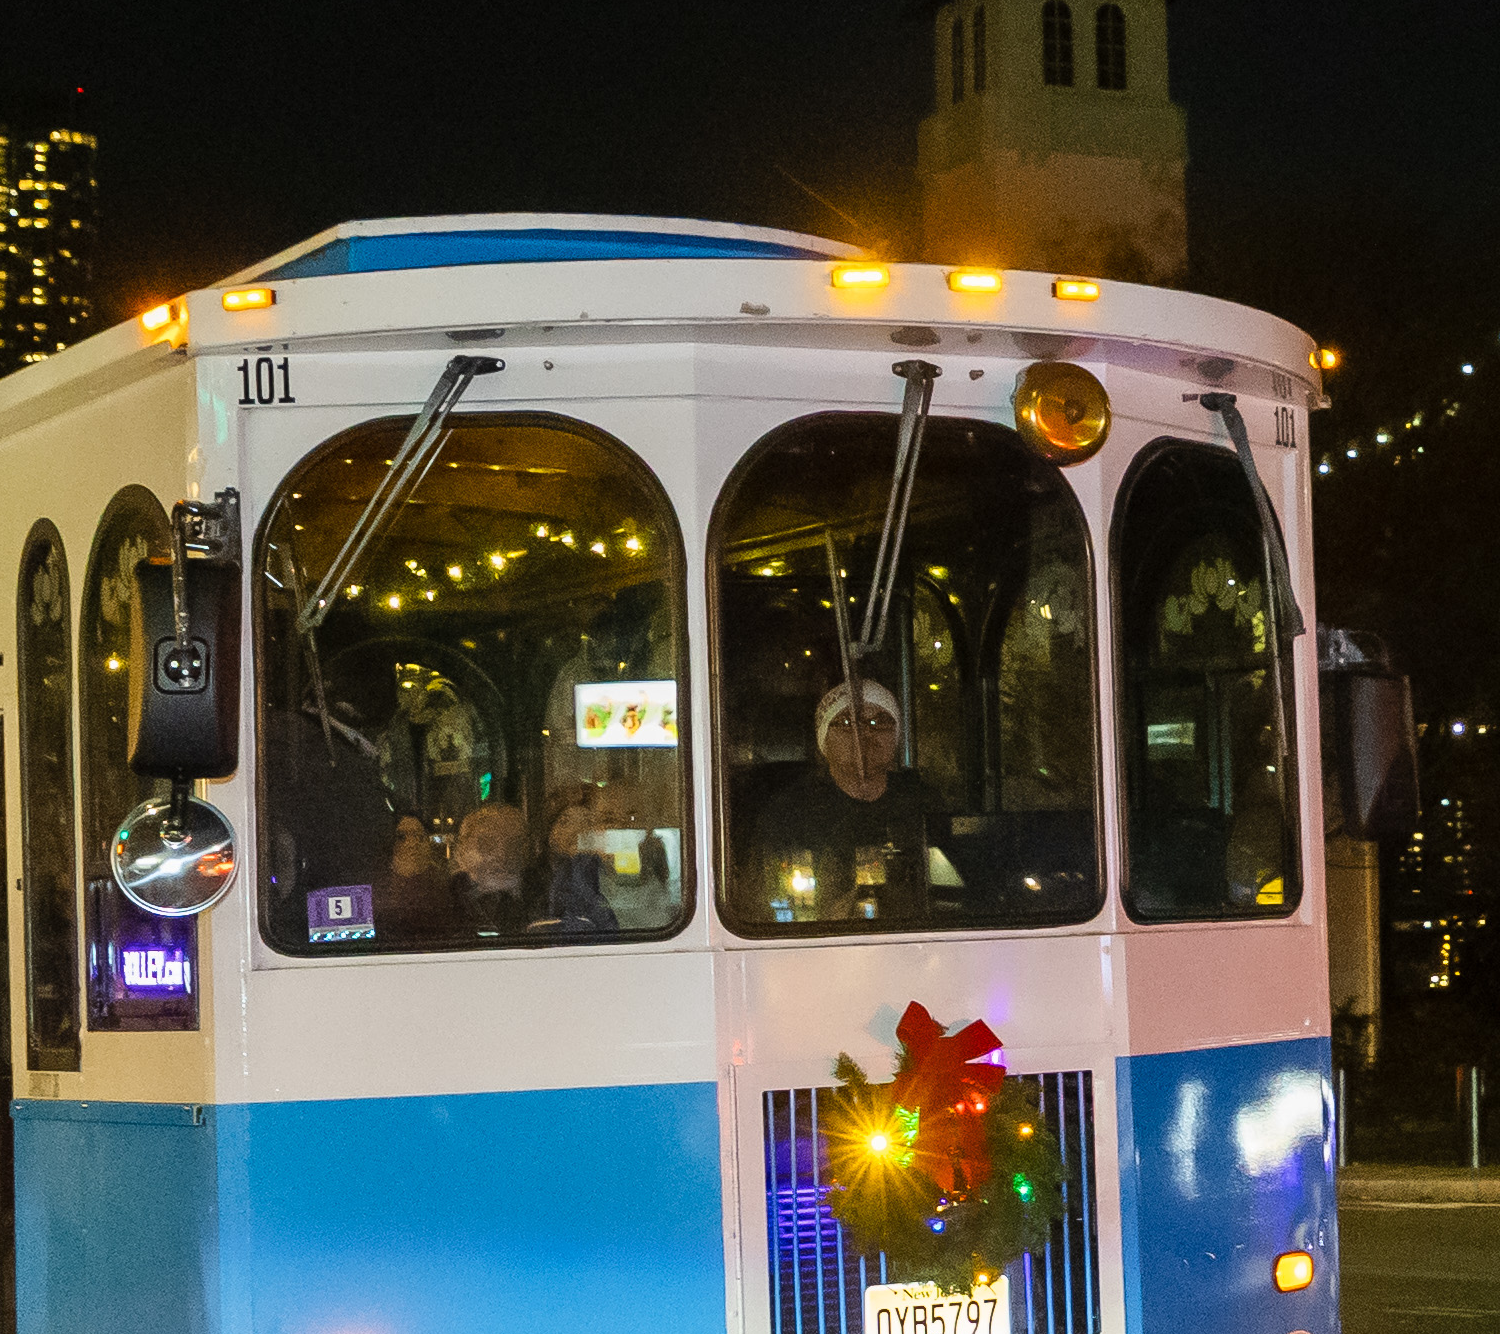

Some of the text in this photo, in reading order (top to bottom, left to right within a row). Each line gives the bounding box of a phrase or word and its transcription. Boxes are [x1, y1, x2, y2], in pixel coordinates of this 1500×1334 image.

[237, 357, 296, 405] 101
[1274, 406, 1297, 448] 101
[334, 899, 343, 916] 5
[902, 1288, 933, 1301] New
